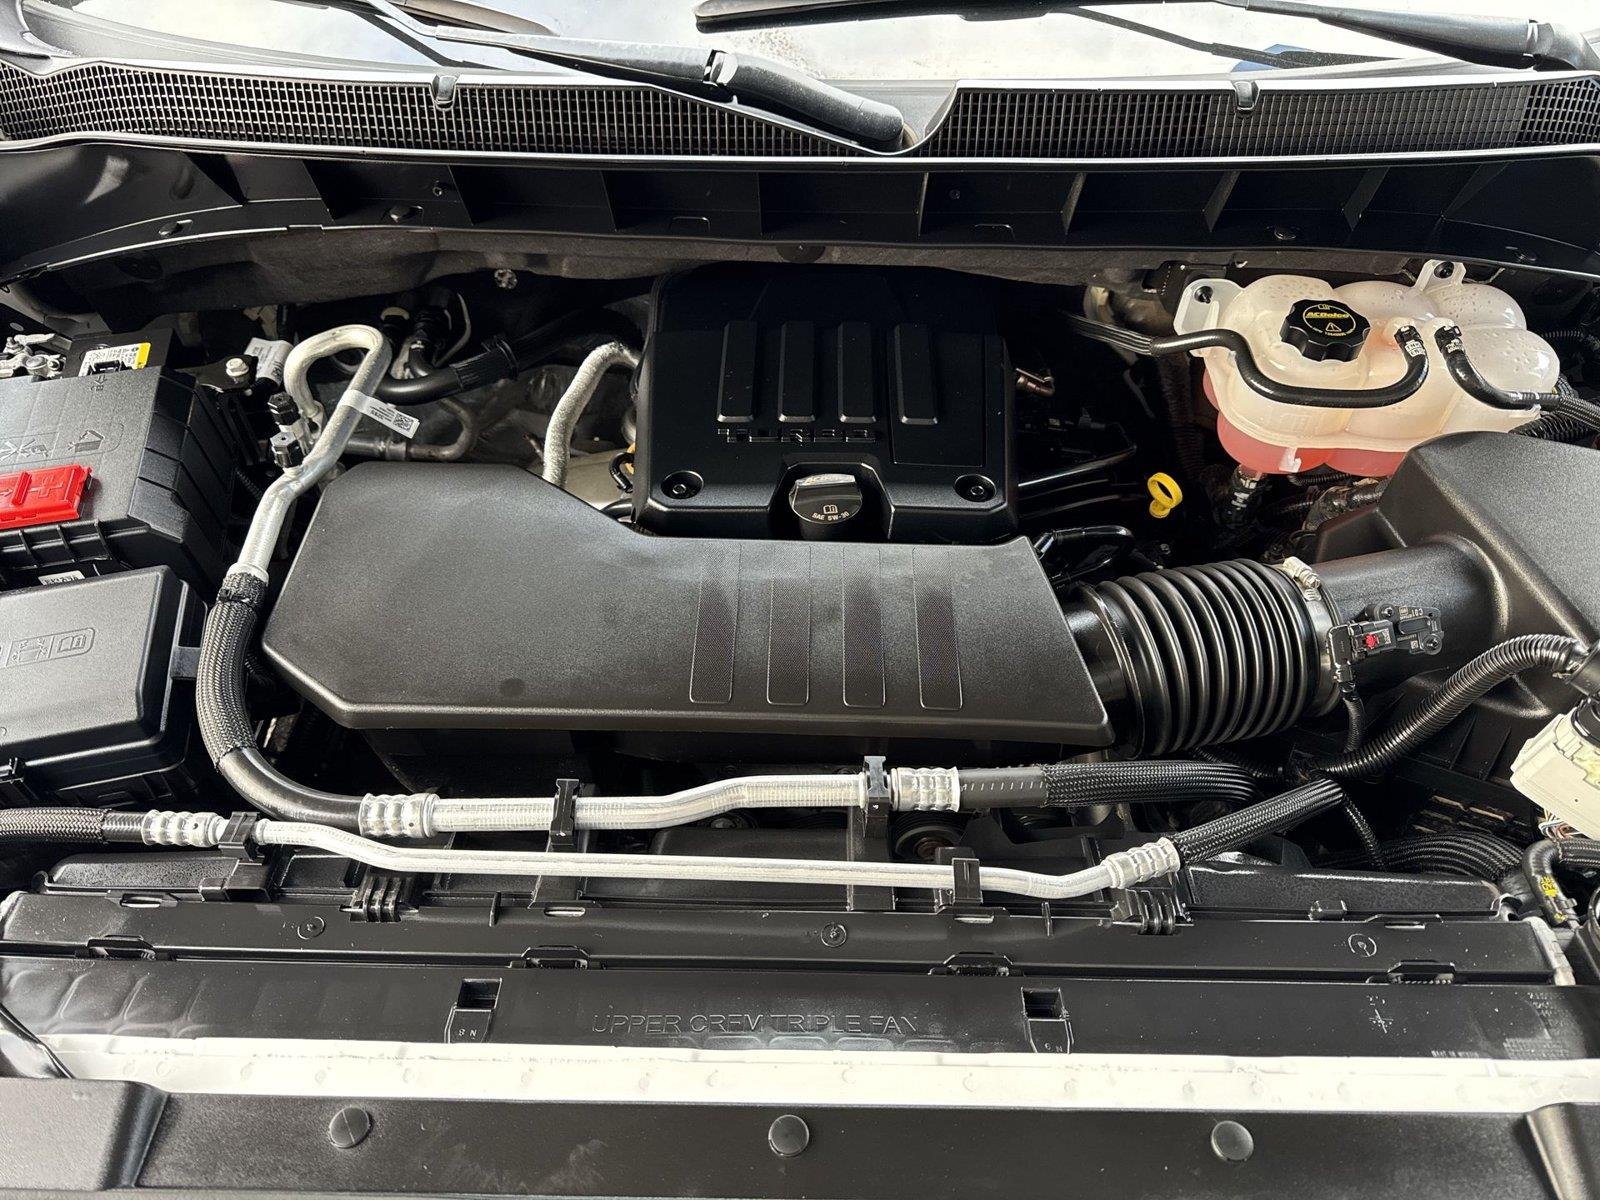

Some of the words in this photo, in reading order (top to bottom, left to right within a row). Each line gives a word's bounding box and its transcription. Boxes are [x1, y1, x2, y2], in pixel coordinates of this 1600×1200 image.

[1305, 311, 1350, 319] ACDelco
[812, 512, 826, 520] SAE
[827, 511, 850, 521] 5W-30
[592, 1014, 682, 1033] UPPER
[770, 1014, 862, 1033] TRIPLE
[869, 1015, 917, 1034] FAN
